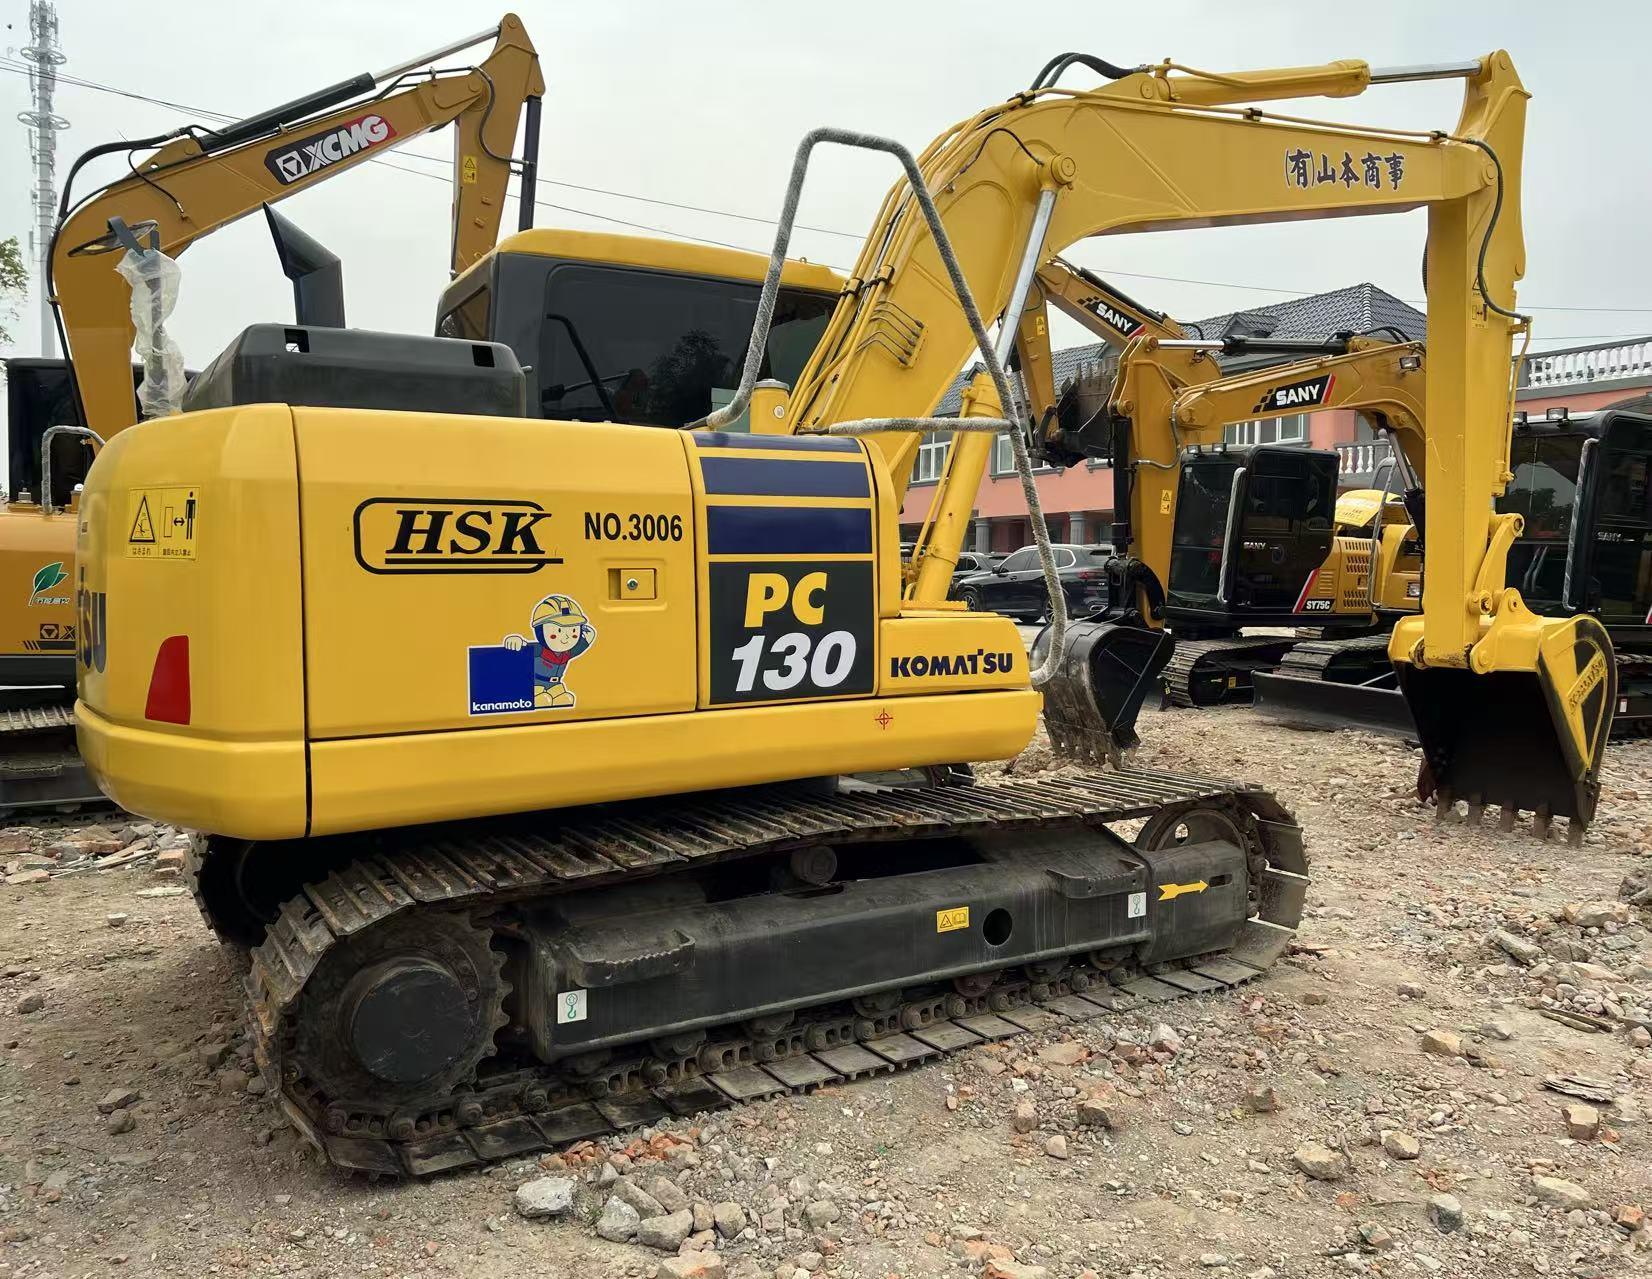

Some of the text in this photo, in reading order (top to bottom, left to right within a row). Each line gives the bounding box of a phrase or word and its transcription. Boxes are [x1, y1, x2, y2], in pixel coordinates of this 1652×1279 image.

[302, 116, 388, 172] XCMG
[1096, 302, 1133, 332] SANY
[1275, 384, 1320, 406] SANY
[385, 510, 552, 555] HSK
[584, 511, 683, 542] NO.3006
[744, 571, 828, 628] PC
[1306, 600, 1331, 610] SY75C
[731, 630, 857, 692] 130
[890, 648, 1013, 678] KOMATSU
[472, 698, 533, 712] kanamoto
